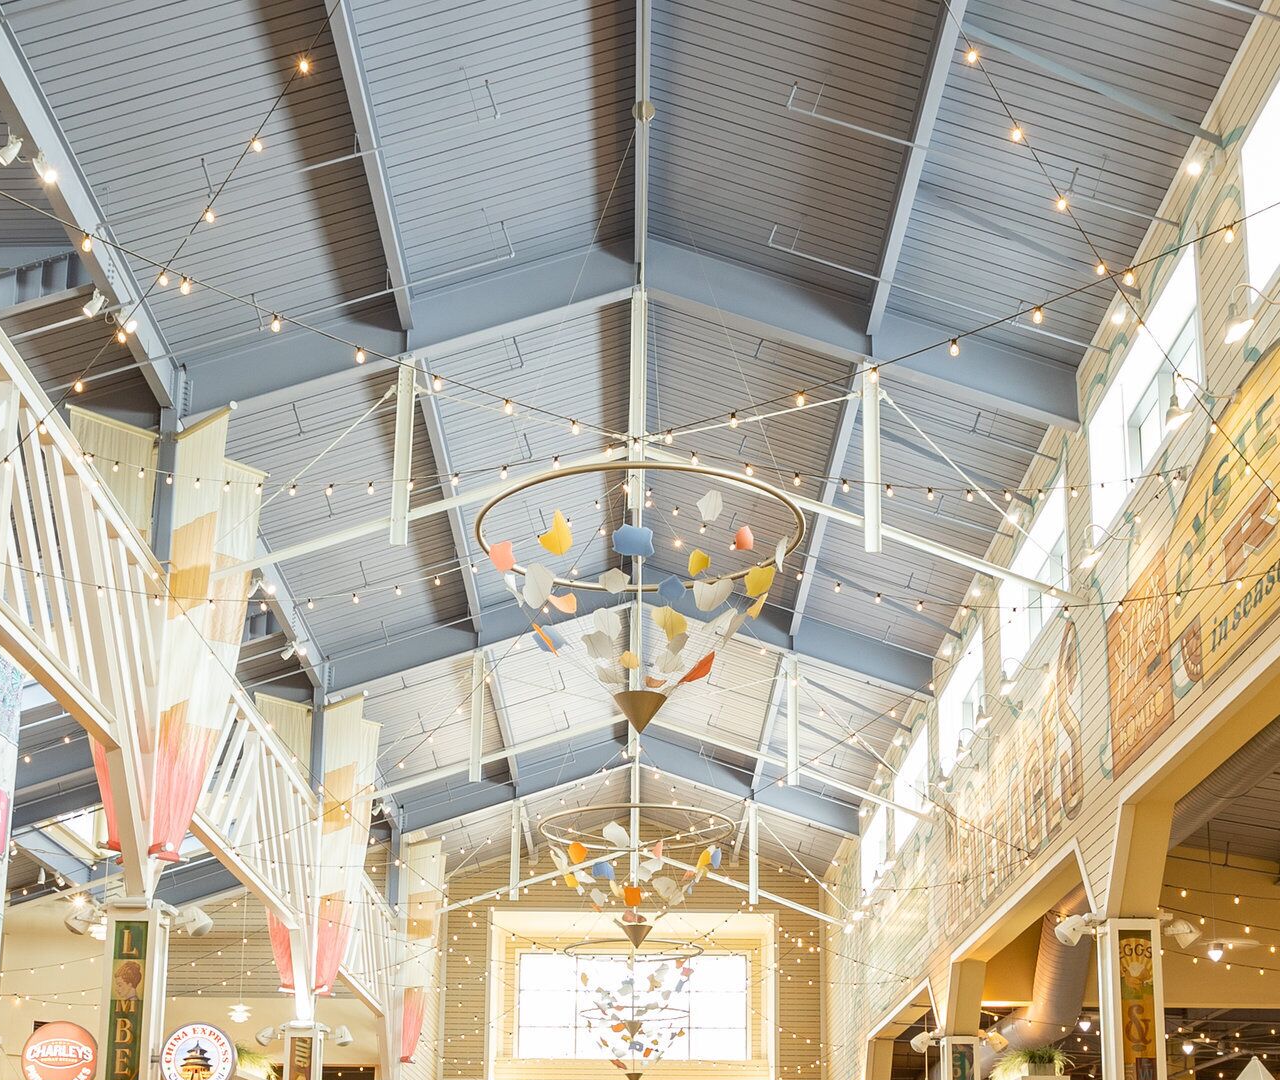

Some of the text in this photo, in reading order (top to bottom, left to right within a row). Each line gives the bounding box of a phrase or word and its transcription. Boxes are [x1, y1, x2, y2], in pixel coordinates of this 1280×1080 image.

[1125, 1004, 1151, 1044] &
[26, 1045, 93, 1062] CHARLEYS
[165, 1027, 229, 1064] CHINA EXPRESS
